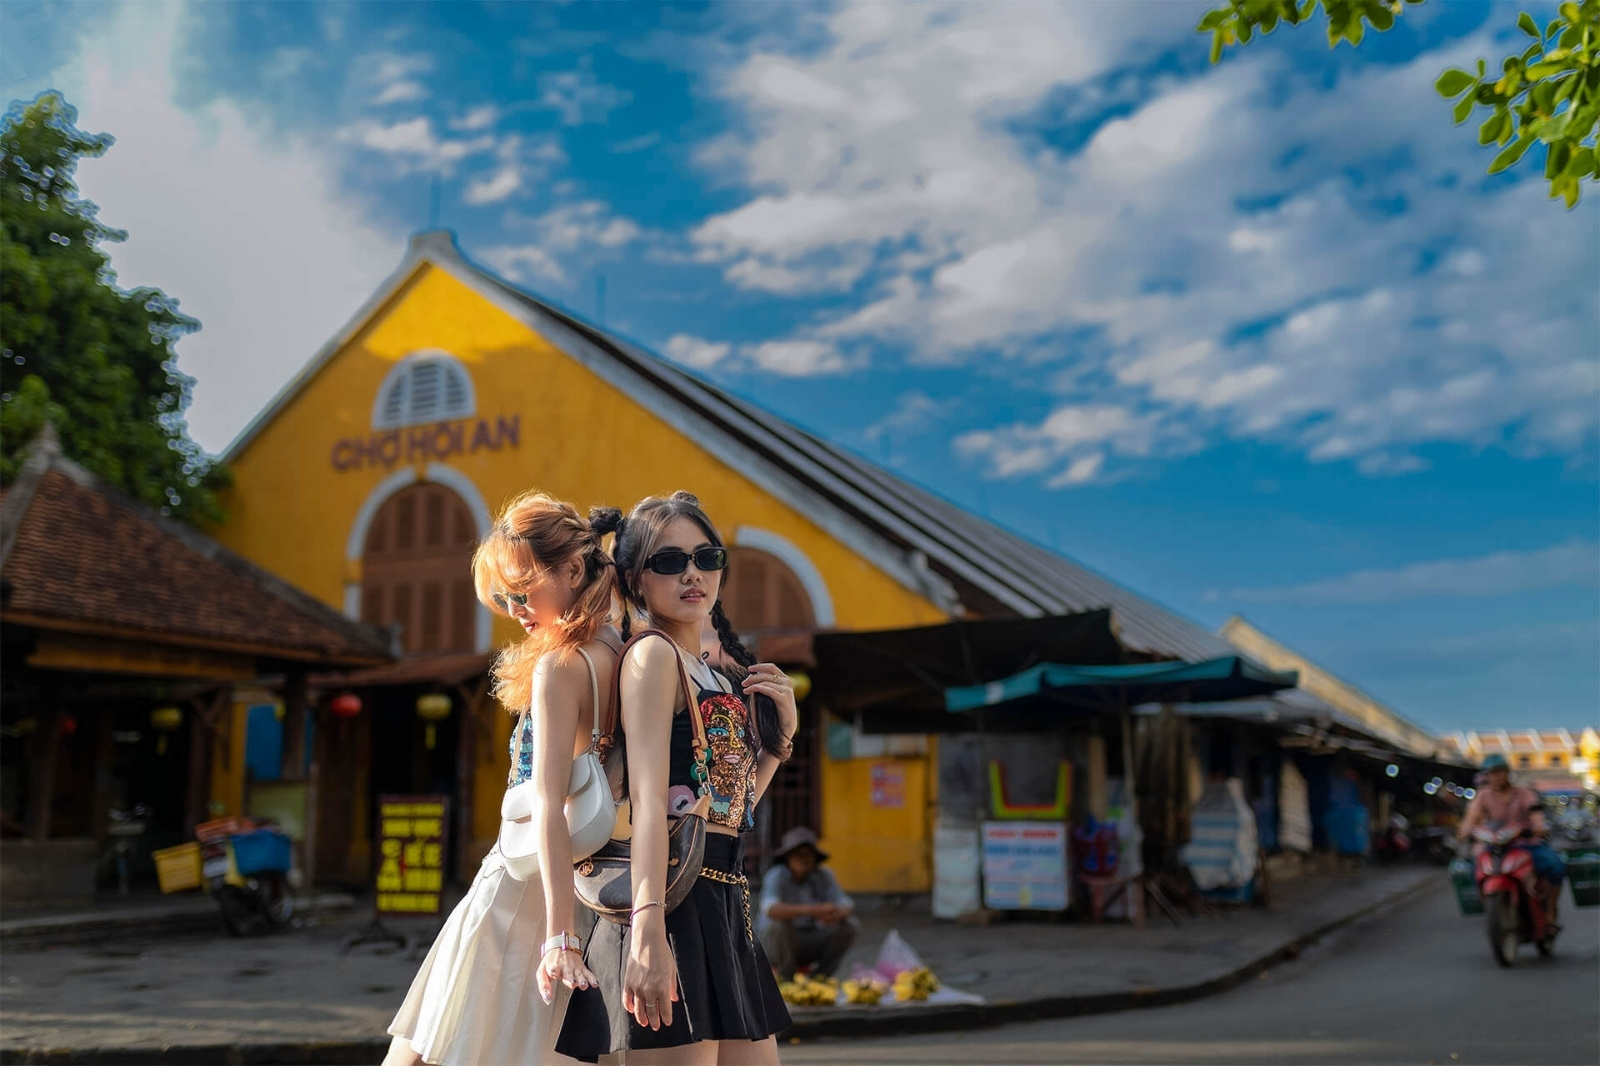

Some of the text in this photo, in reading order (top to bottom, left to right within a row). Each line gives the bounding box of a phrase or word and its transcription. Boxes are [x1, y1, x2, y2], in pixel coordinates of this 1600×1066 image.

[331, 414, 521, 472] CHỢ HỘI AN
